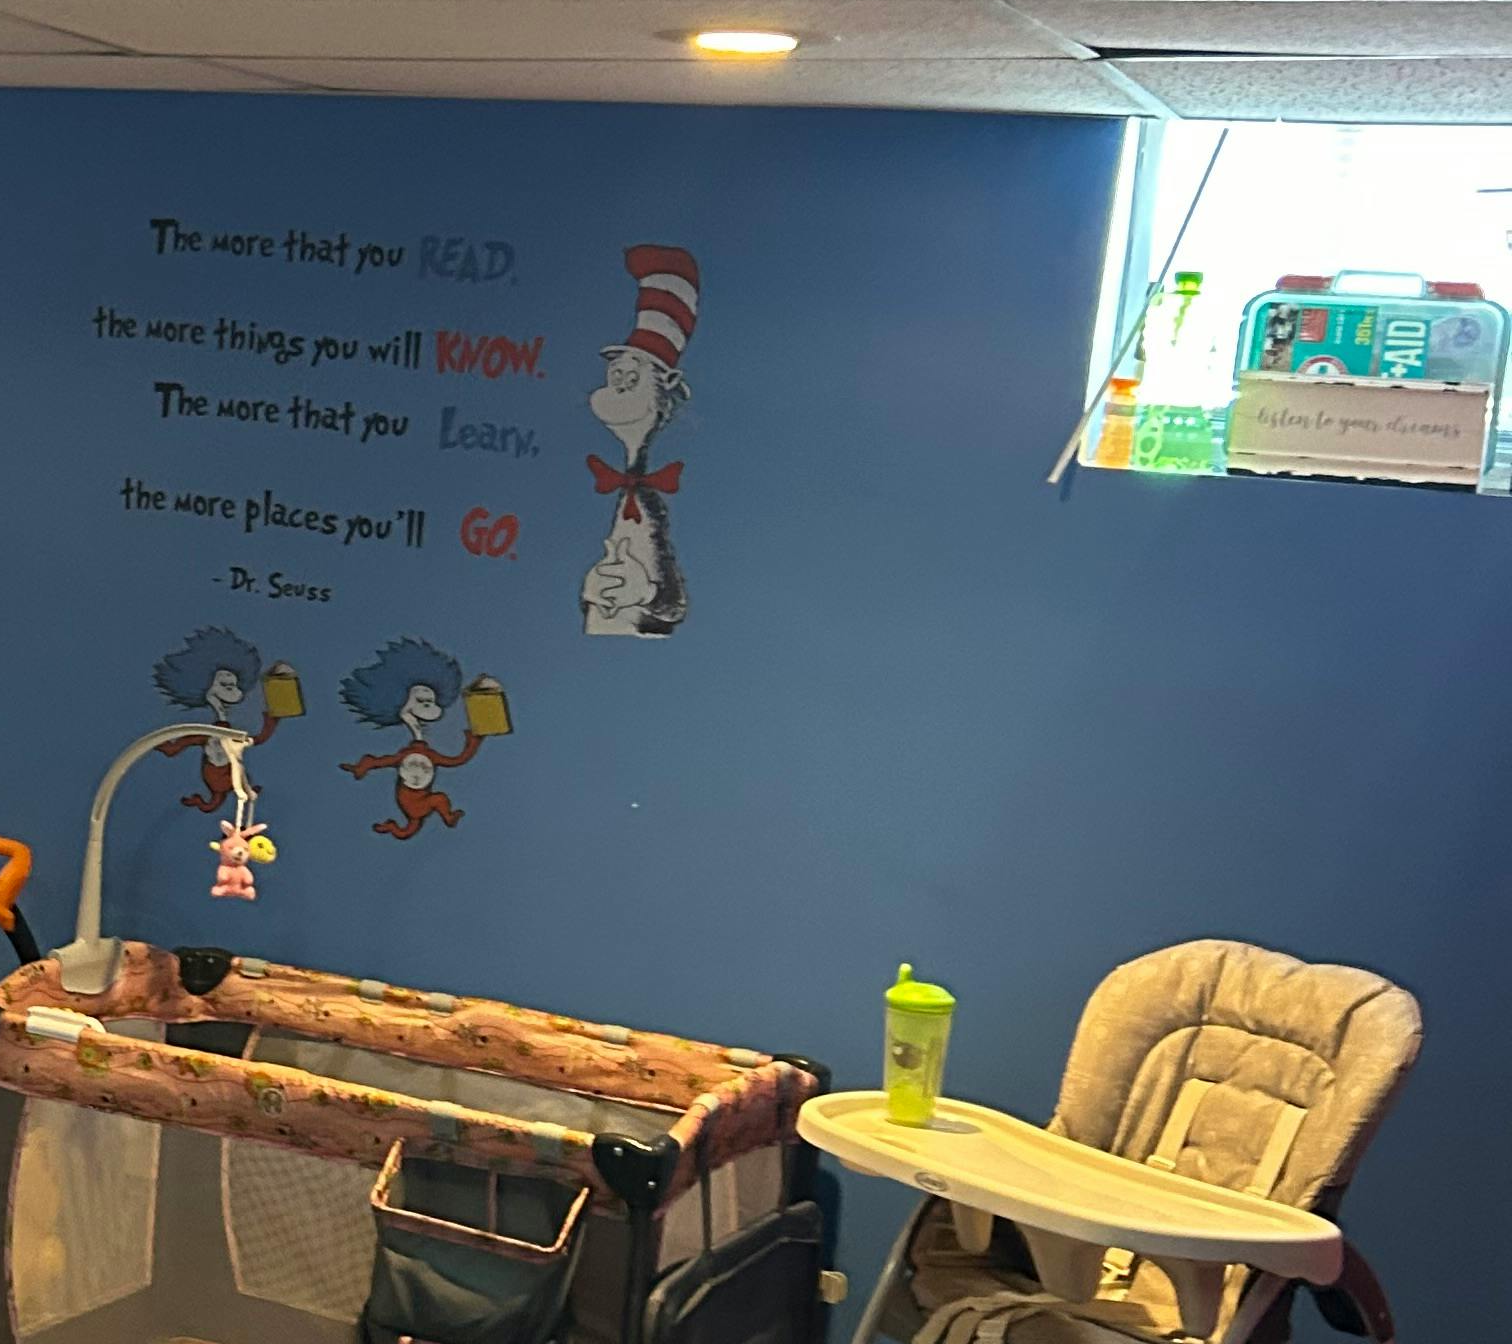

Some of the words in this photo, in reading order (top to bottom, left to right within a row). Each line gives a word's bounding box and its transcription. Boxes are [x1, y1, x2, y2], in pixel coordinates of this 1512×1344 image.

[150, 219, 203, 255] The
[211, 233, 274, 257] more
[282, 229, 350, 267] that
[355, 243, 404, 275] you
[92, 306, 138, 338] the
[145, 320, 206, 345] more
[213, 317, 305, 366] things
[310, 335, 358, 368] you
[368, 330, 422, 370] will
[155, 382, 208, 418] The
[216, 398, 280, 423] more
[285, 395, 356, 436] that
[361, 411, 410, 443] you
[1337, 415, 1379, 435] your
[119, 477, 169, 511] the
[173, 493, 236, 519] more
[244, 489, 339, 536] places
[342, 509, 426, 549] you'll
[229, 565, 260, 593] Dr.
[267, 572, 332, 603] Seuss
